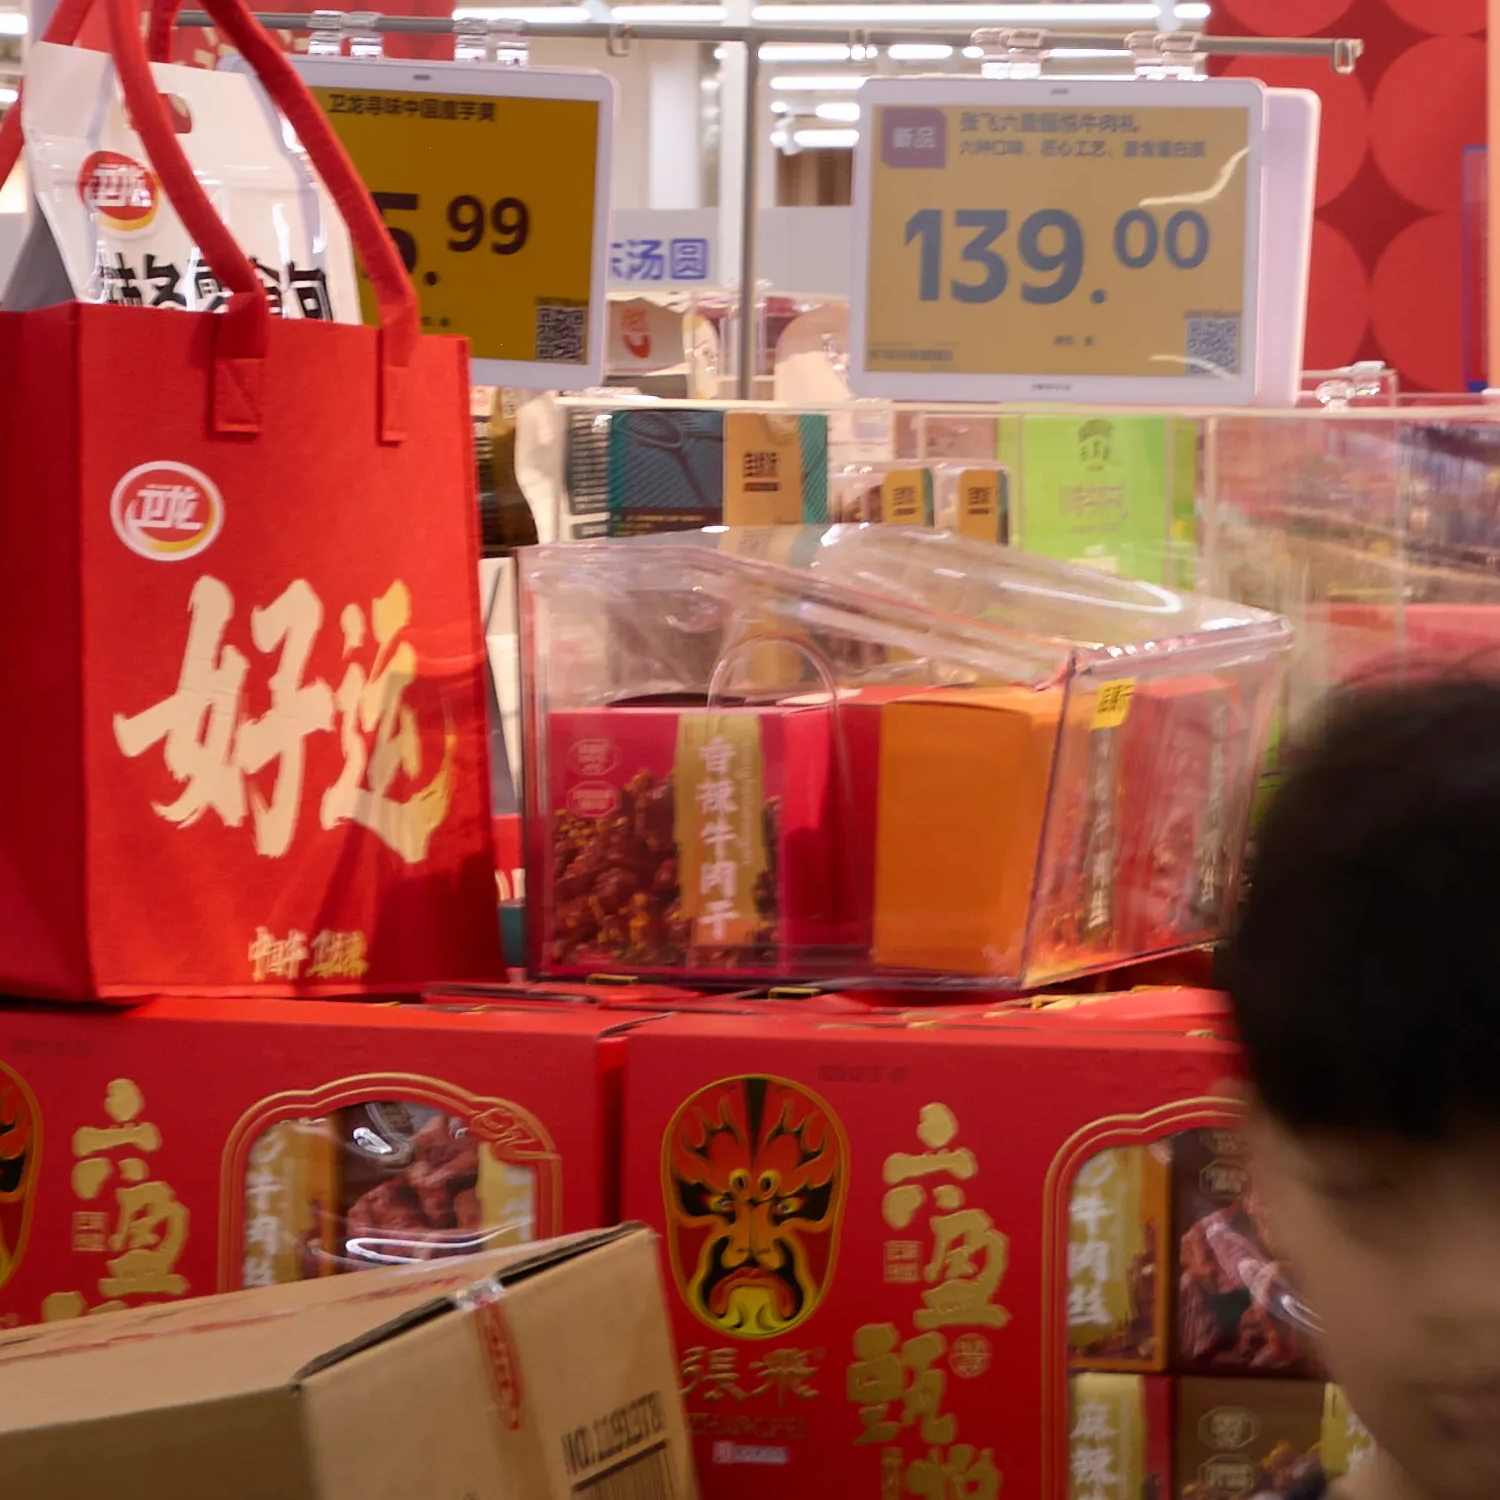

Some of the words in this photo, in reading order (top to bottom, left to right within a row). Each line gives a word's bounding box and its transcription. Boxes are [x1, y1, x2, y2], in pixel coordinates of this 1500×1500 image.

[132, 483, 207, 531] 卫龙
[695, 736, 742, 941] 香辣牛肉干
